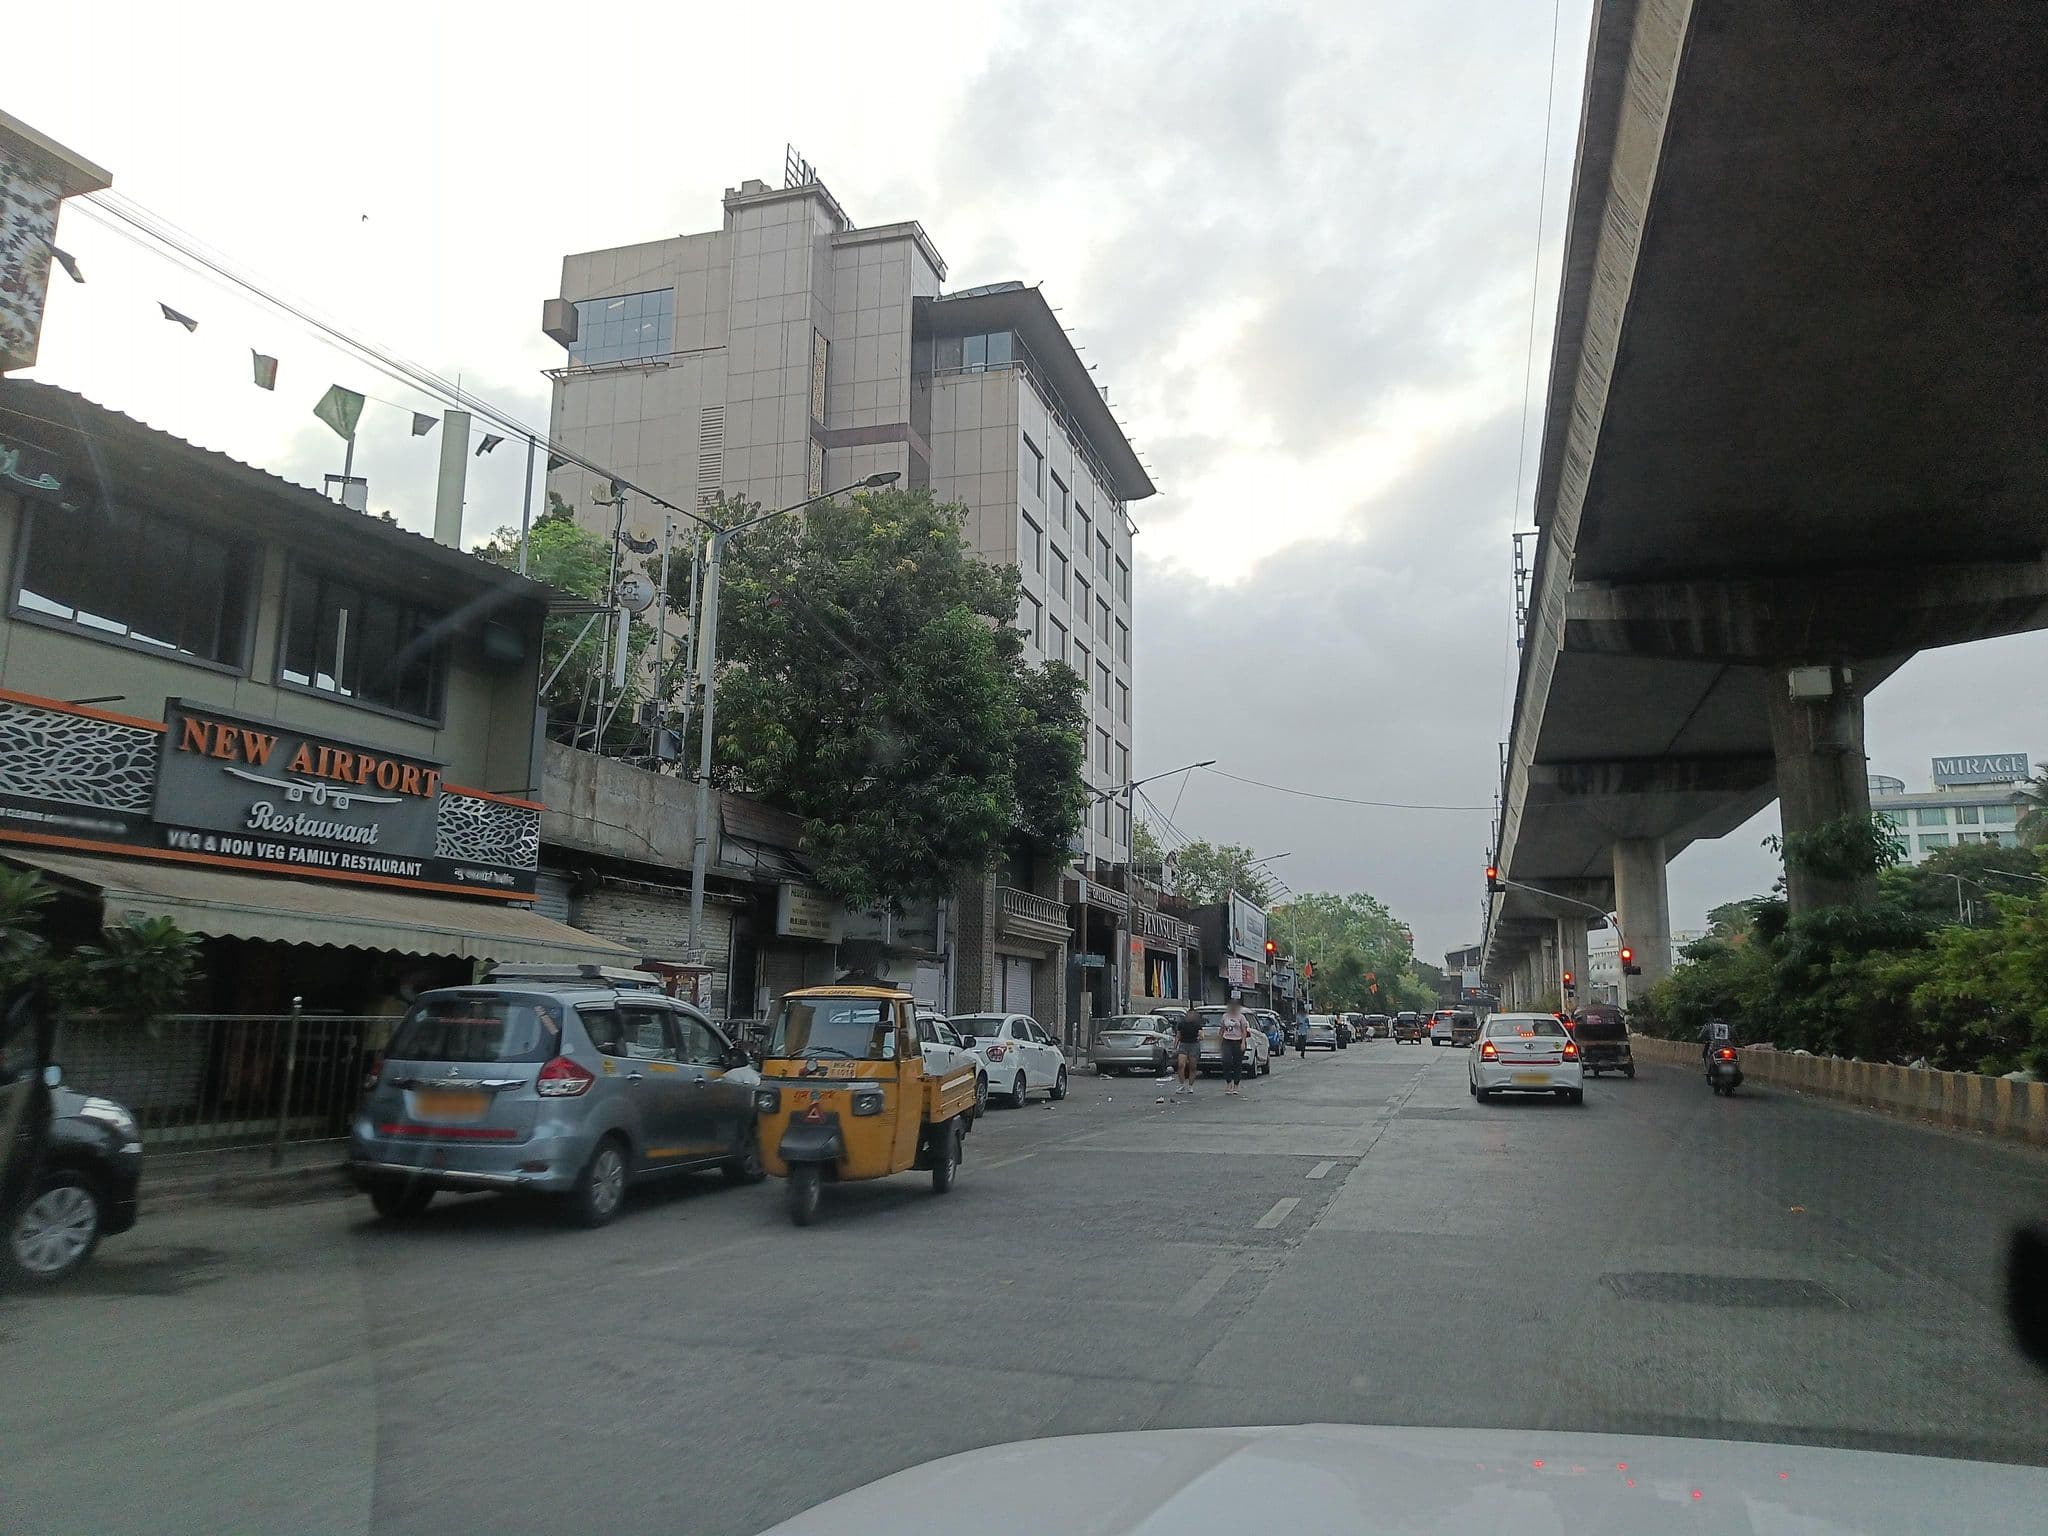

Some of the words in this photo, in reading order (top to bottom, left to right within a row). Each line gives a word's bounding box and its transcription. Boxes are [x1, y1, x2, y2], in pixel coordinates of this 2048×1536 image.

[178, 716, 279, 766] NEW
[286, 741, 441, 799] AIRPORT
[1936, 756, 2025, 775] MIRAGE
[246, 801, 380, 846] Restaurant
[220, 838, 252, 856] NON
[257, 843, 286, 860] VEG
[288, 846, 340, 867] FAMILY
[341, 855, 423, 877] RESTAURANT
